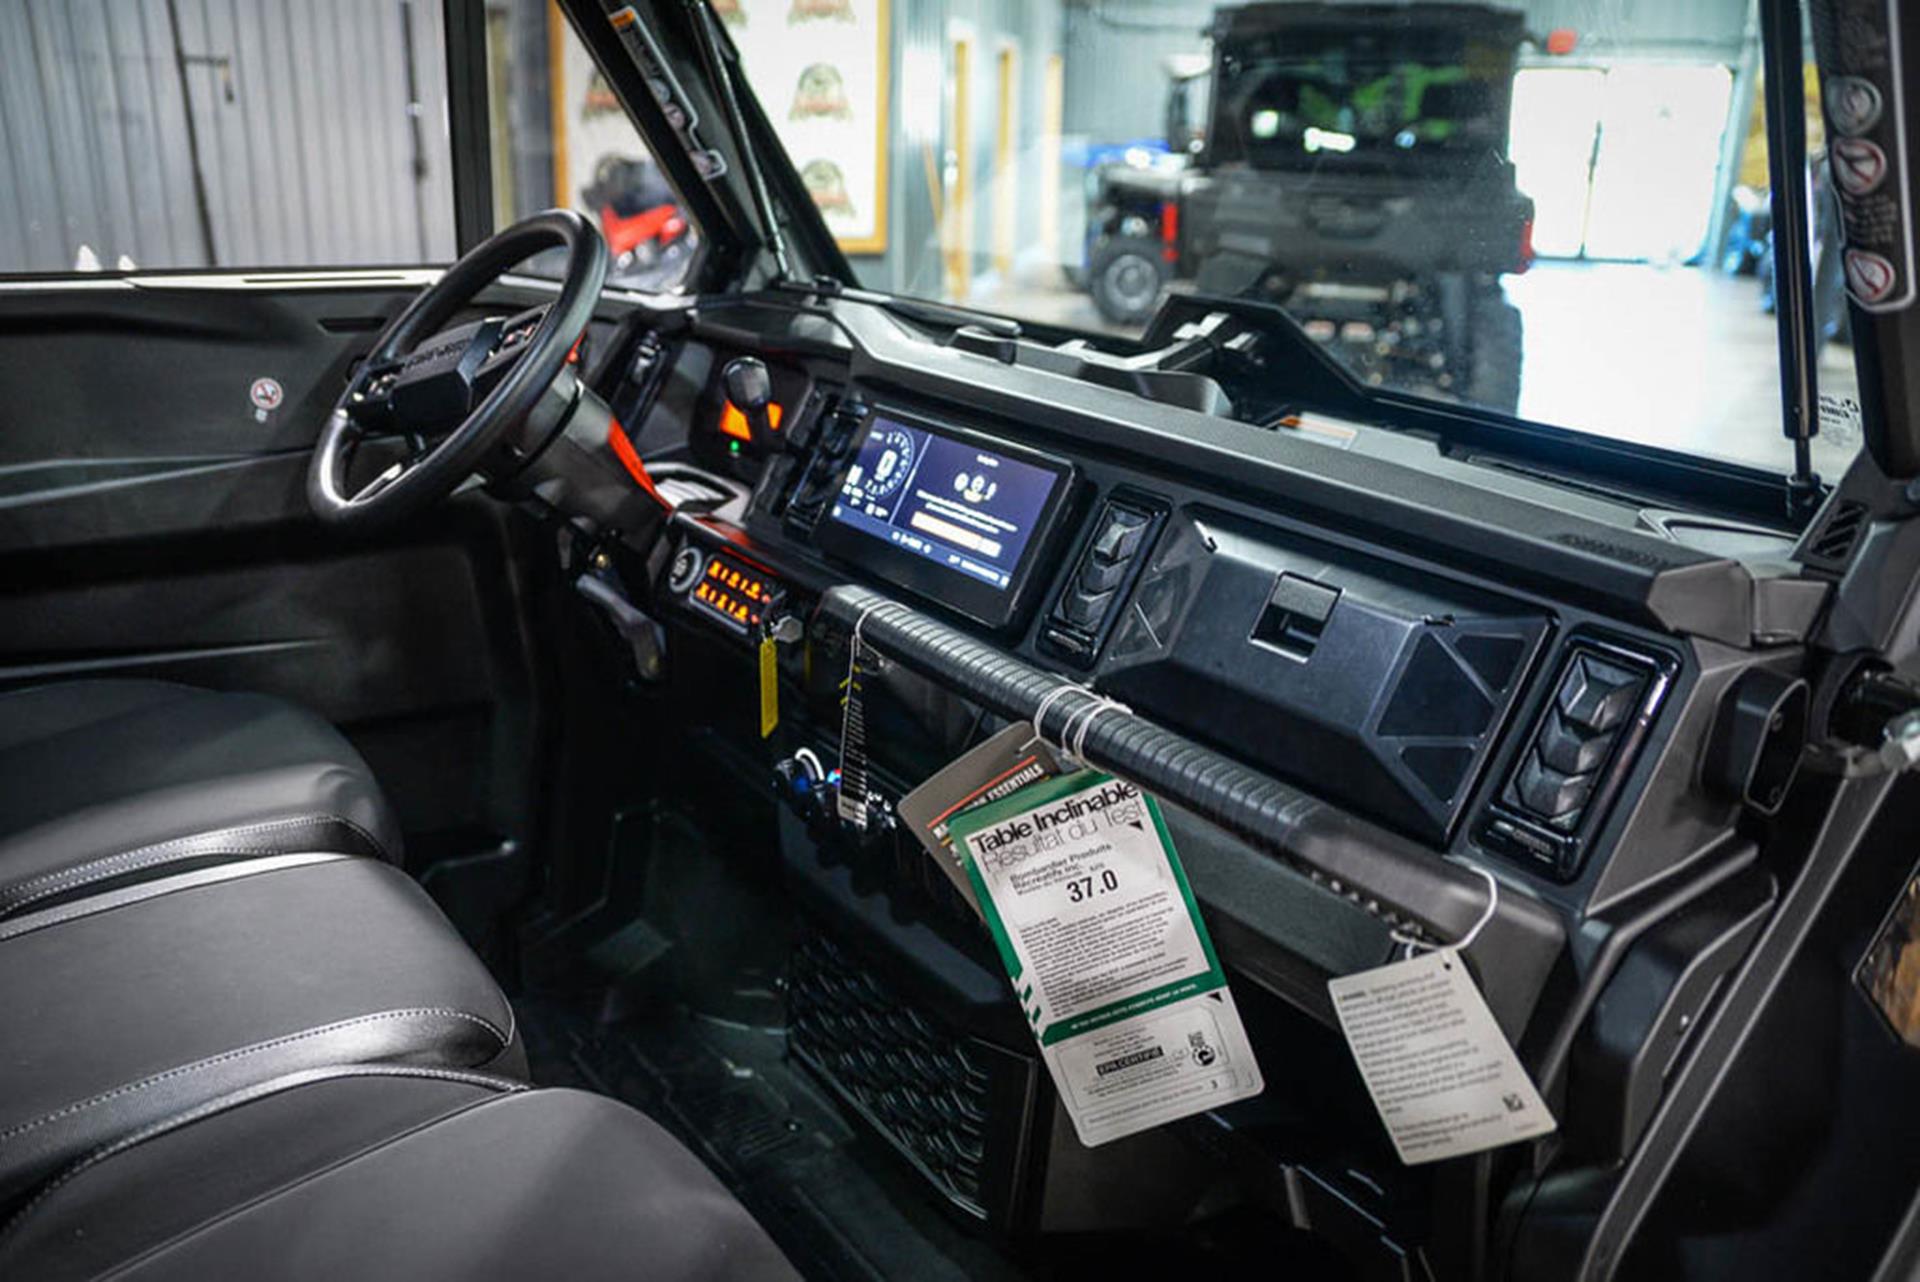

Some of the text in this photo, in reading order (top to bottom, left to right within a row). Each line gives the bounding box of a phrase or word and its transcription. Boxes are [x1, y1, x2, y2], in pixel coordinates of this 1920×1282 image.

[987, 763, 1044, 801] ESSENTIALS
[969, 822, 1033, 853] Table
[1032, 782, 1138, 832] Inclinable
[1069, 820, 1098, 841] du
[1100, 801, 1145, 827] Test
[1066, 869, 1118, 903] 37.0
